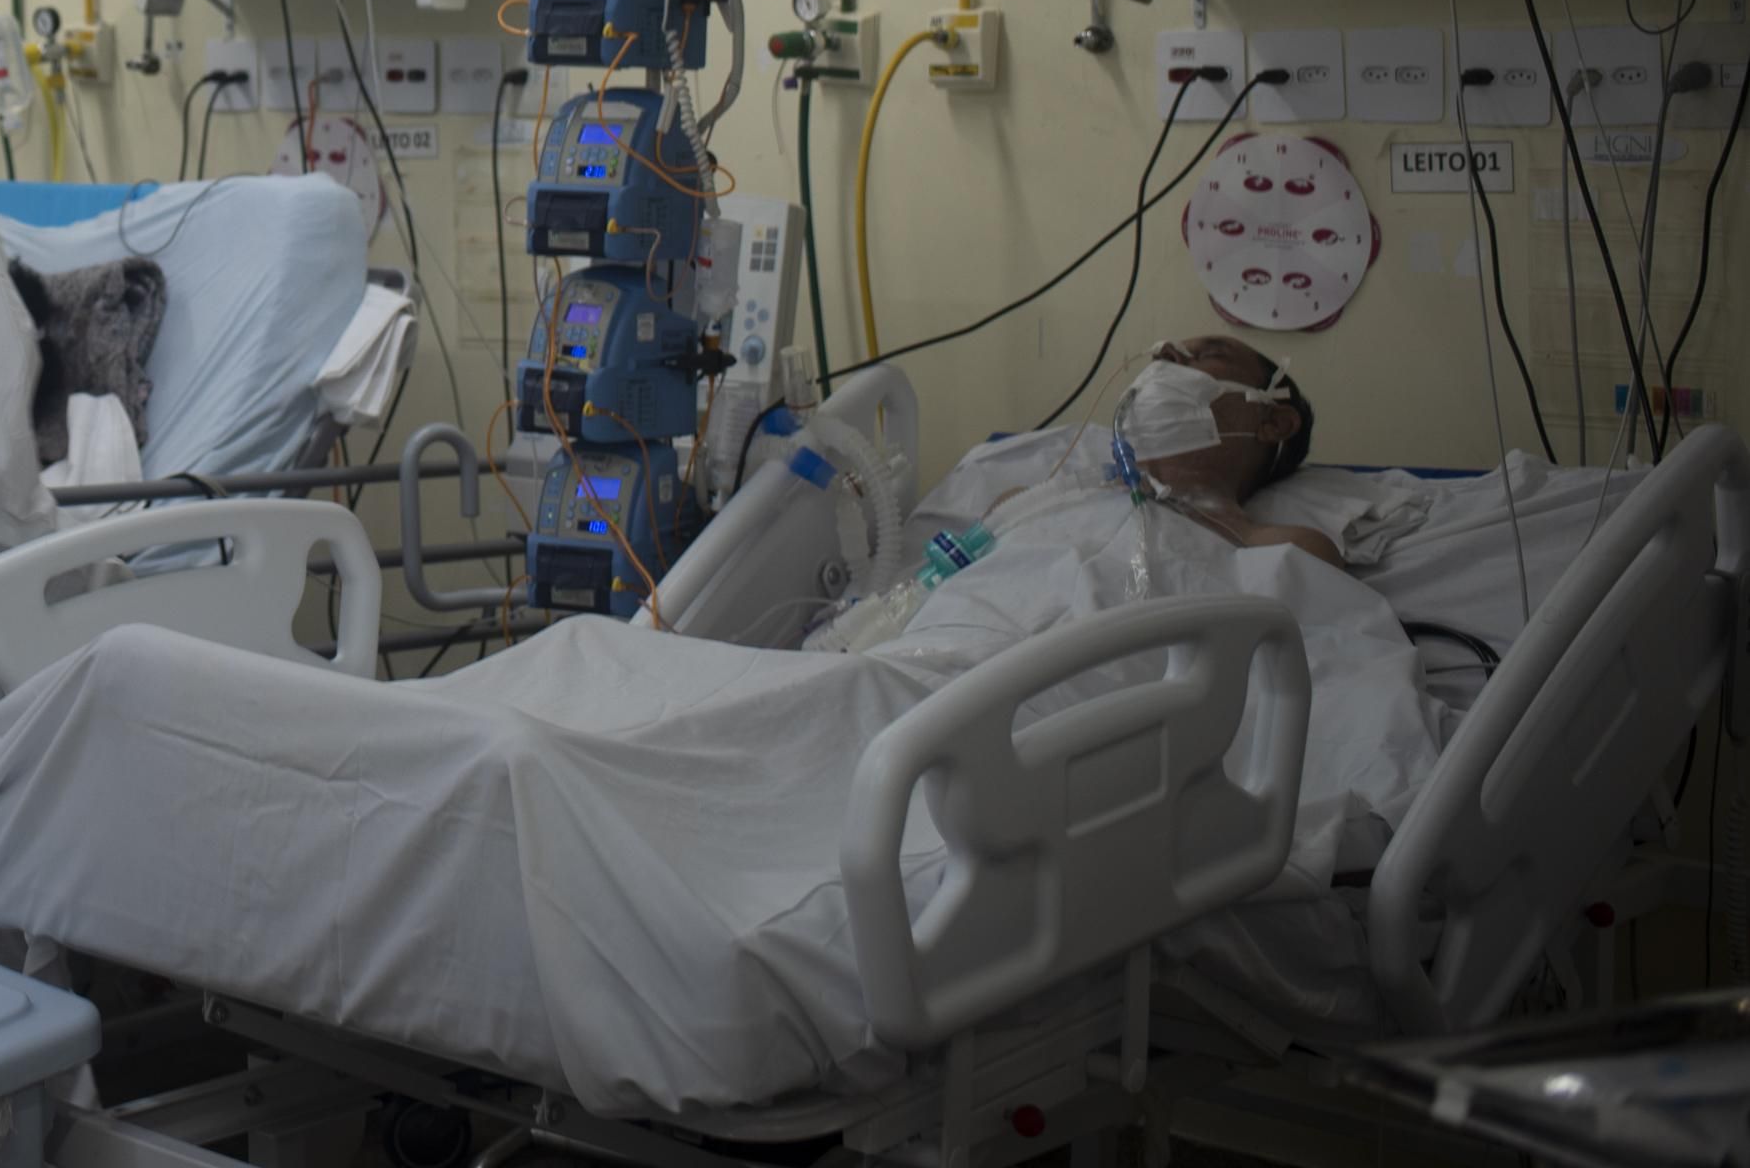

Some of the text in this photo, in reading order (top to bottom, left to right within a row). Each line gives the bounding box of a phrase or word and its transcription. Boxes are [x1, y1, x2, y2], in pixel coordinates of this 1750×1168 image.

[413, 132, 430, 148] 02
[1403, 152, 1500, 172] LEITO 01
